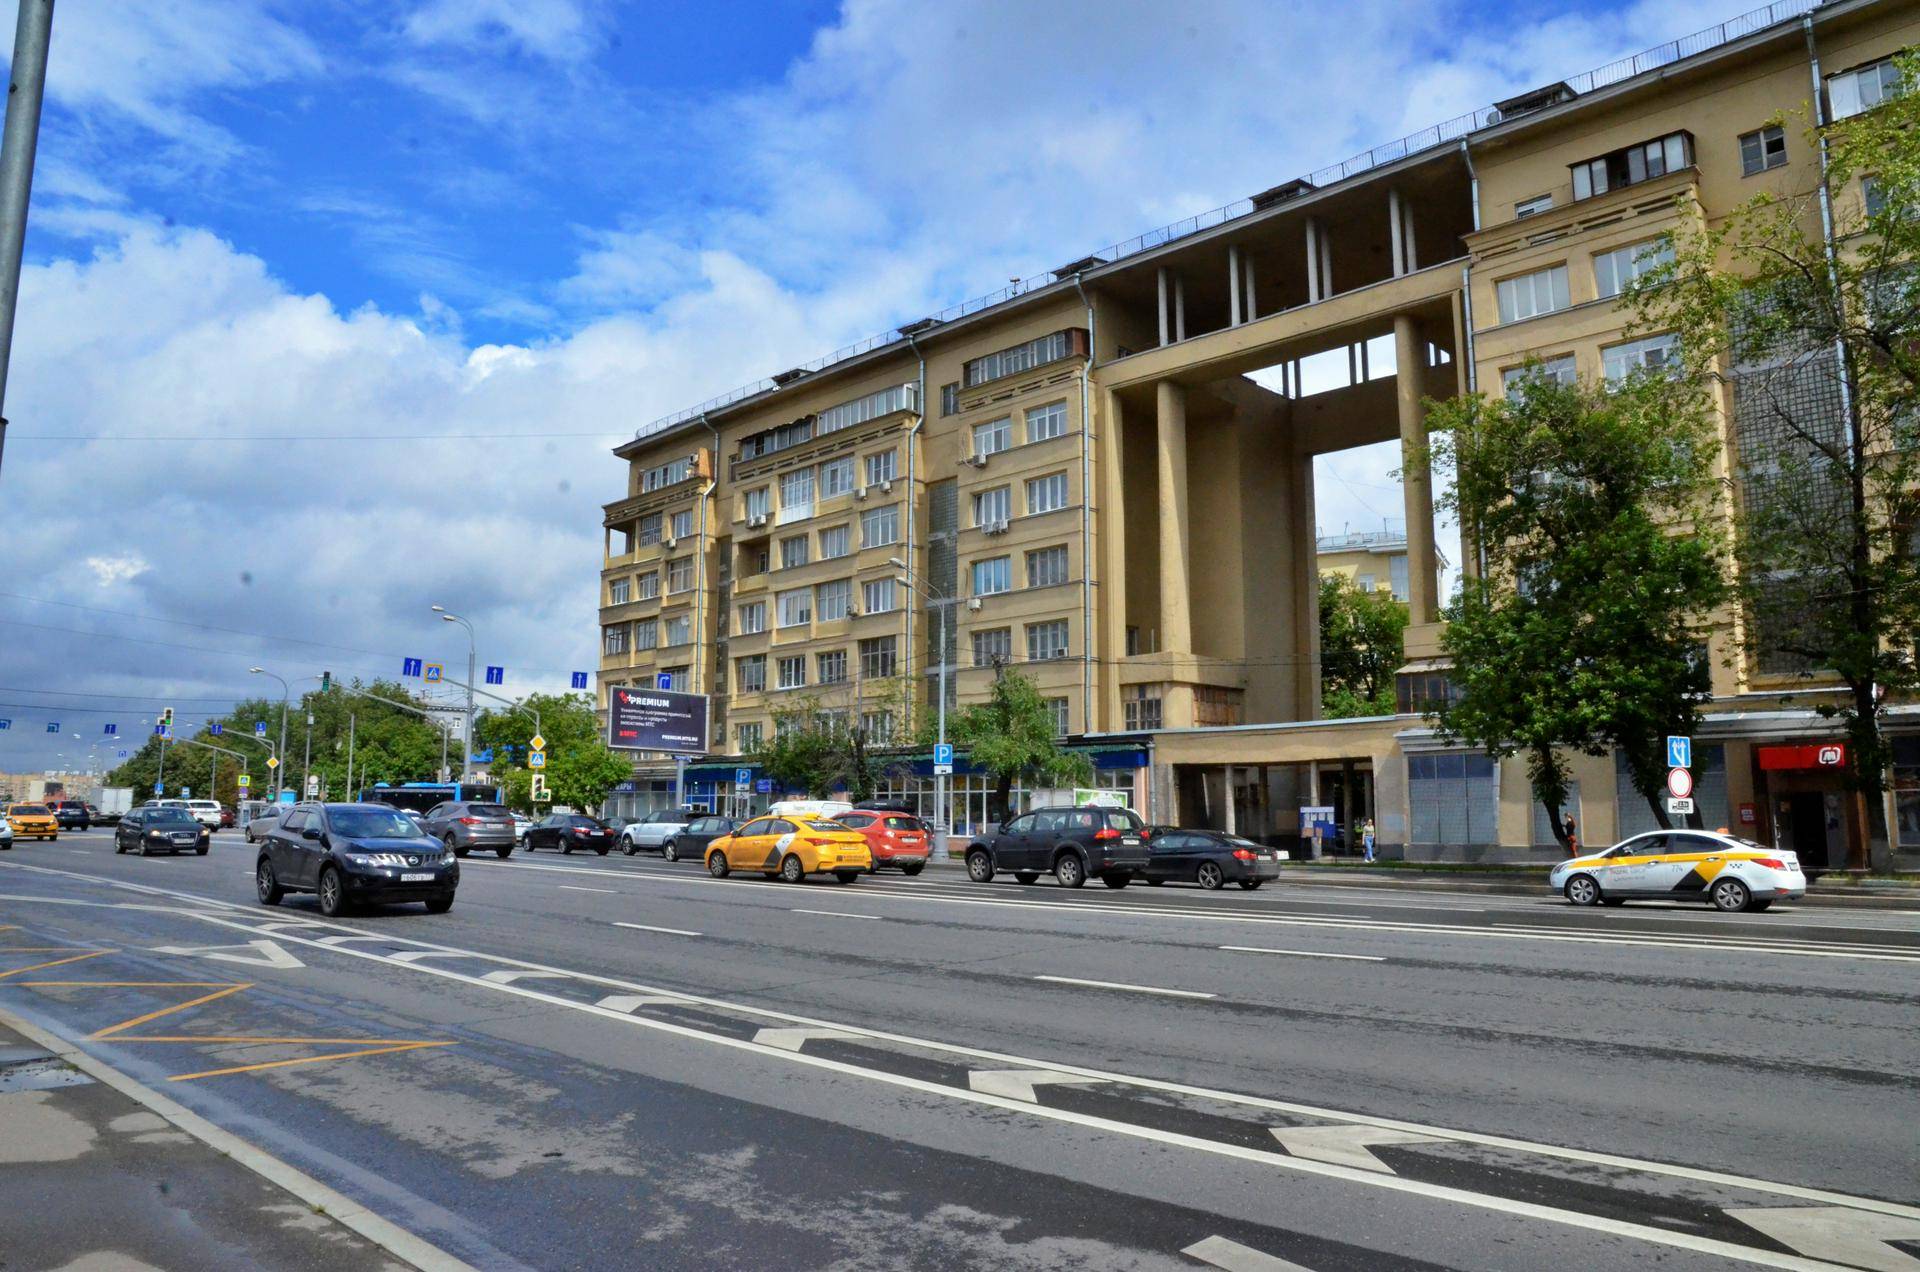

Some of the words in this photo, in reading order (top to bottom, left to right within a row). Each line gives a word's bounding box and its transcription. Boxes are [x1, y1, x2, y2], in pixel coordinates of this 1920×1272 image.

[630, 697, 670, 707] PREMIUM
[939, 746, 949, 762] P
[740, 770, 749, 784] P
